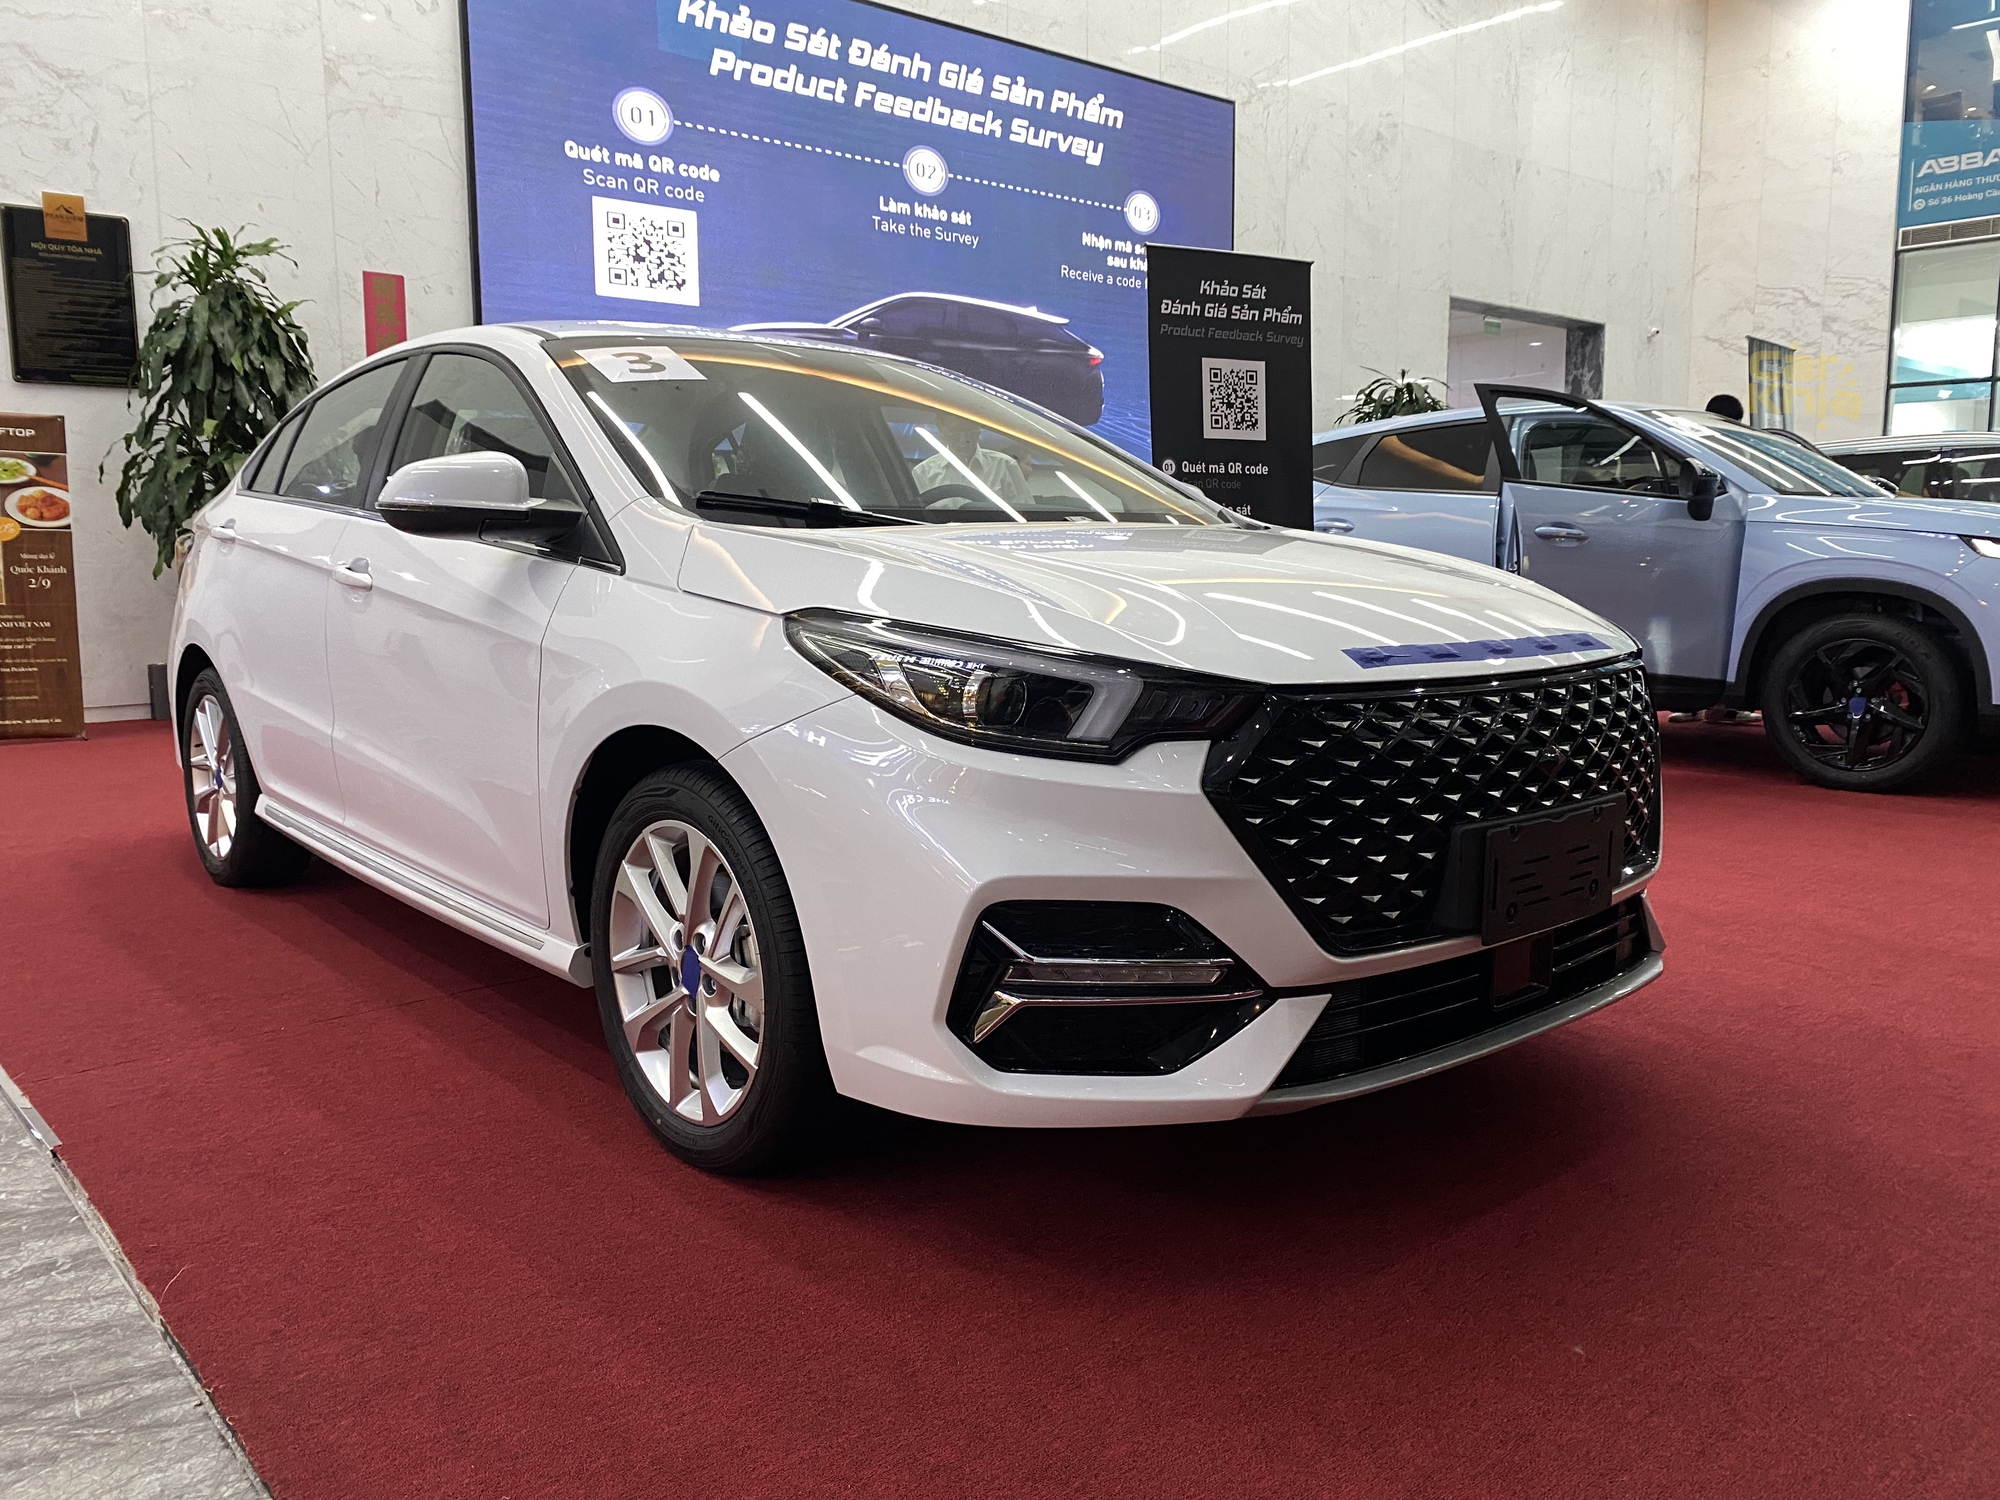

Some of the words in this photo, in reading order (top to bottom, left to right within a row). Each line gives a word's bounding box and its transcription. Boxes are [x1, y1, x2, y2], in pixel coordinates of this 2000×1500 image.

[677, 0, 776, 44] Khảo
[784, 22, 841, 60] Sát
[848, 38, 931, 82] Đánh
[938, 61, 984, 95] Giá
[991, 74, 1044, 109] Sản
[1050, 93, 1124, 129] Phẩm
[630, 106, 654, 127] 01
[710, 47, 847, 103] Product
[854, 81, 1002, 138] Feedback
[1009, 117, 1104, 166] Survey
[564, 140, 610, 164] Quét
[614, 152, 644, 170] mã
[648, 155, 675, 175] QR
[678, 164, 720, 182] code
[916, 162, 936, 180] 02
[583, 168, 628, 191] Scan
[633, 177, 659, 196] QR
[664, 185, 705, 203] code
[1915, 182, 1943, 194] NGÂN
[1944, 178, 1973, 190] HÀNG
[1928, 196, 1940, 206] Số
[1942, 195, 1953, 204] 36
[1955, 191, 1984, 202] Hoàng
[879, 195, 911, 216] Làm
[914, 201, 948, 222] khảo
[951, 210, 972, 226] sát
[872, 215, 905, 235] Take
[910, 222, 931, 239] the
[935, 226, 979, 249] Survey
[1082, 231, 1112, 252] Nhận
[1115, 240, 1132, 253] mã
[30, 241, 46, 251] NỘI
[48, 243, 66, 252] QUY
[67, 245, 83, 254] TÒA
[84, 247, 102, 255] NHÀ
[1107, 255, 1127, 269] sau
[1061, 264, 1104, 284] Receive
[1106, 275, 1113, 285] a
[1116, 276, 1142, 289] code
[1200, 279, 1239, 298] Khảo
[1242, 284, 1267, 300] Sát
[1160, 299, 1201, 316] Đánh
[1204, 300, 1228, 318] Giá
[1231, 304, 1260, 322] Sản
[1263, 306, 1303, 325] Phẩm
[1160, 323, 1206, 338] Product
[1208, 327, 1264, 342] Feedback
[1266, 331, 1304, 347] Survey
[612, 352, 667, 373] 3
[1164, 462, 1174, 472] 01
[1182, 460, 1206, 474] Quét
[1209, 463, 1225, 474] mã
[1228, 463, 1242, 474] QR
[1245, 463, 1269, 475] code
[1205, 479, 1219, 489] QR
[1221, 479, 1242, 489] code
[1236, 504, 1251, 515] sát
[10, 562, 35, 575] Quốc
[37, 564, 67, 574] Khánh
[28, 576, 51, 589] 2/9
